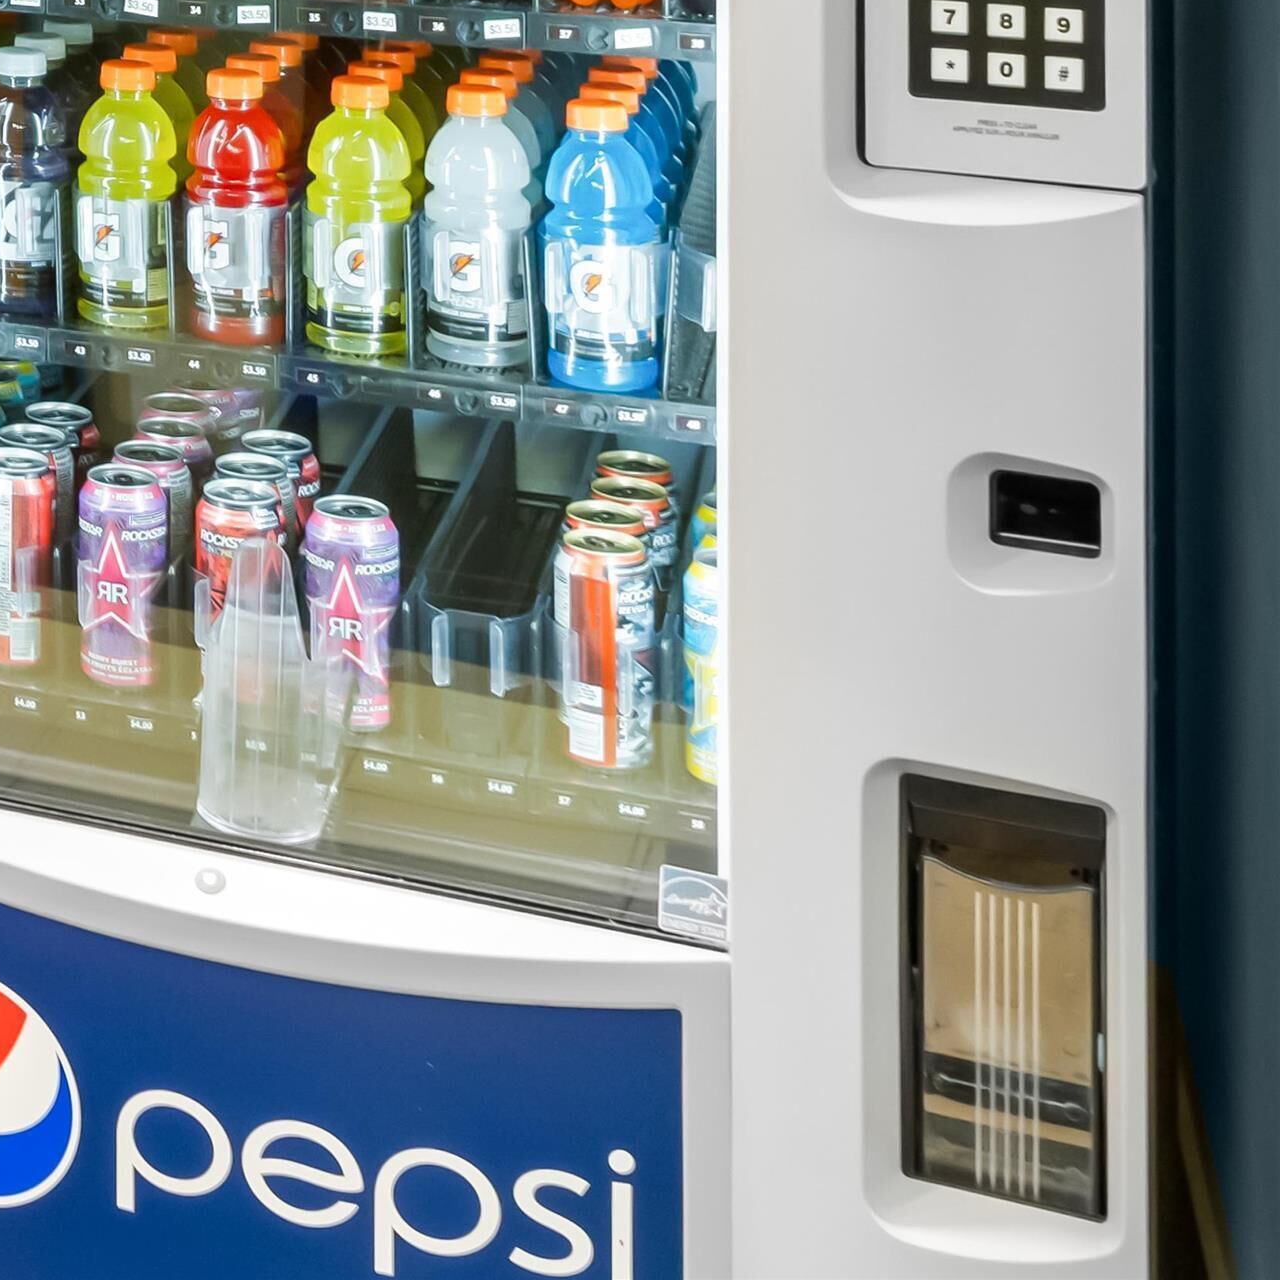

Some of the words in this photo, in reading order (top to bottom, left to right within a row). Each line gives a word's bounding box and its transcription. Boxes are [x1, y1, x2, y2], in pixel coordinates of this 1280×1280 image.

[127, 0, 154, 12] $3.50
[189, 6, 201, 15] 34
[241, 9, 269, 20] $3.50
[308, 13, 320, 22] 35
[943, 9, 956, 25] 7
[365, 16, 394, 28] $3.50
[431, 22, 444, 31] 36
[999, 13, 1013, 30] 8
[1056, 17, 1071, 34] 9
[488, 23, 518, 34] $3.50
[999, 61, 1013, 78] 0
[1057, 65, 1070, 81] #
[74, 345, 86, 355] 43
[127, 351, 151, 362] $3.50
[188, 360, 200, 369] 44
[242, 364, 267, 376] $3.50
[307, 374, 319, 383] 45
[14, 697, 37, 709] $4.00
[364, 759, 388, 772] $4.00
[115, 1088, 637, 1280] pepsi
